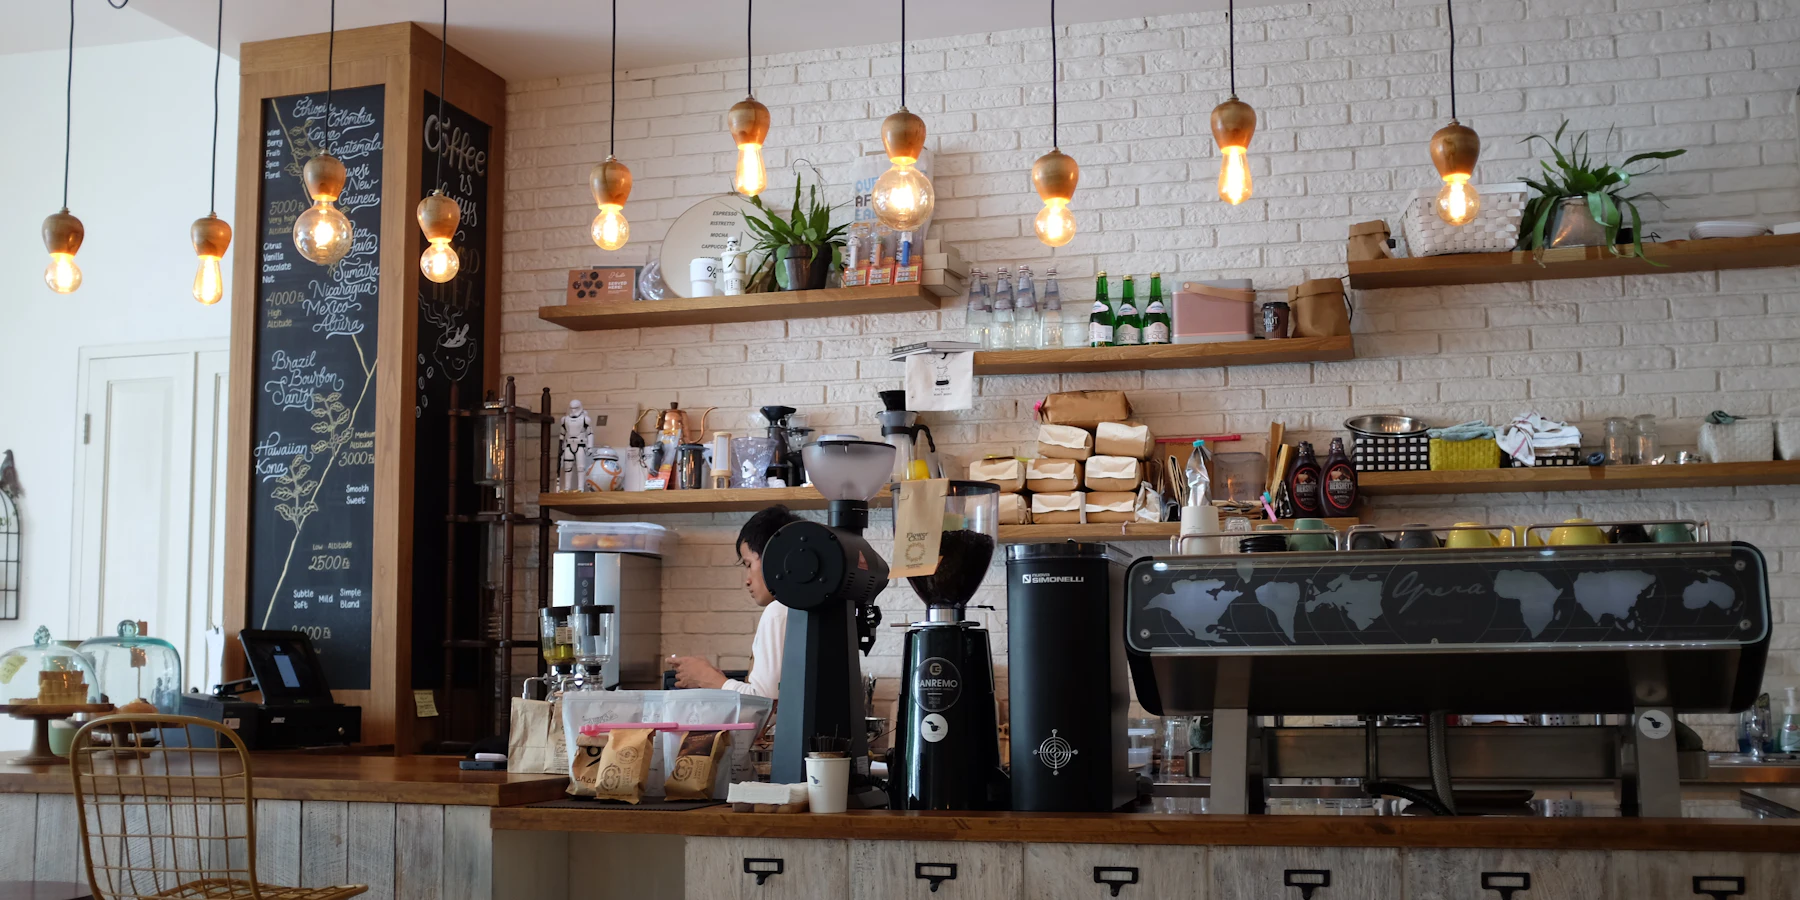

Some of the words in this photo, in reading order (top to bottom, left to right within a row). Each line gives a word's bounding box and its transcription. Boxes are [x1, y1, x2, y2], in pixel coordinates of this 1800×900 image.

[327, 106, 375, 131] Colombia
[266, 140, 283, 148] Berry
[328, 132, 384, 159] Guatemala
[424, 114, 486, 177] Coffee
[266, 149, 281, 157] Fruit
[265, 160, 280, 169] Spice
[265, 171, 281, 180] Floral
[343, 177, 379, 192] New
[459, 171, 473, 196] is
[269, 199, 298, 215] 5000
[338, 189, 380, 210] Guinea
[263, 242, 282, 251] Citrus
[343, 233, 378, 258] Java
[263, 252, 284, 262] Vanilla
[263, 262, 292, 273] Chocolate
[333, 258, 380, 283] Sumatra
[266, 290, 297, 307] 4000
[308, 280, 378, 302] Nicaragua
[267, 308, 281, 319] High
[302, 299, 362, 316] Mexico
[267, 318, 292, 329] Altitude
[312, 314, 364, 337] Altura
[271, 350, 316, 372] Brazil
[288, 366, 344, 391] Bourbon
[264, 376, 315, 411] Santos
[254, 431, 314, 462] Hawaiian
[339, 451, 367, 467] 3000
[255, 458, 289, 480] Kona
[346, 484, 369, 493] Smooth
[346, 496, 366, 505] Sweet
[328, 540, 352, 549] Altitude
[308, 555, 342, 570] 2500
[293, 589, 314, 598] Subtle
[318, 594, 334, 603] Mild
[339, 588, 361, 597] Simple
[1392, 571, 1486, 614] Opera
[293, 601, 308, 609] Soft
[340, 599, 360, 608] Bland
[919, 679, 958, 688] ANREMO
